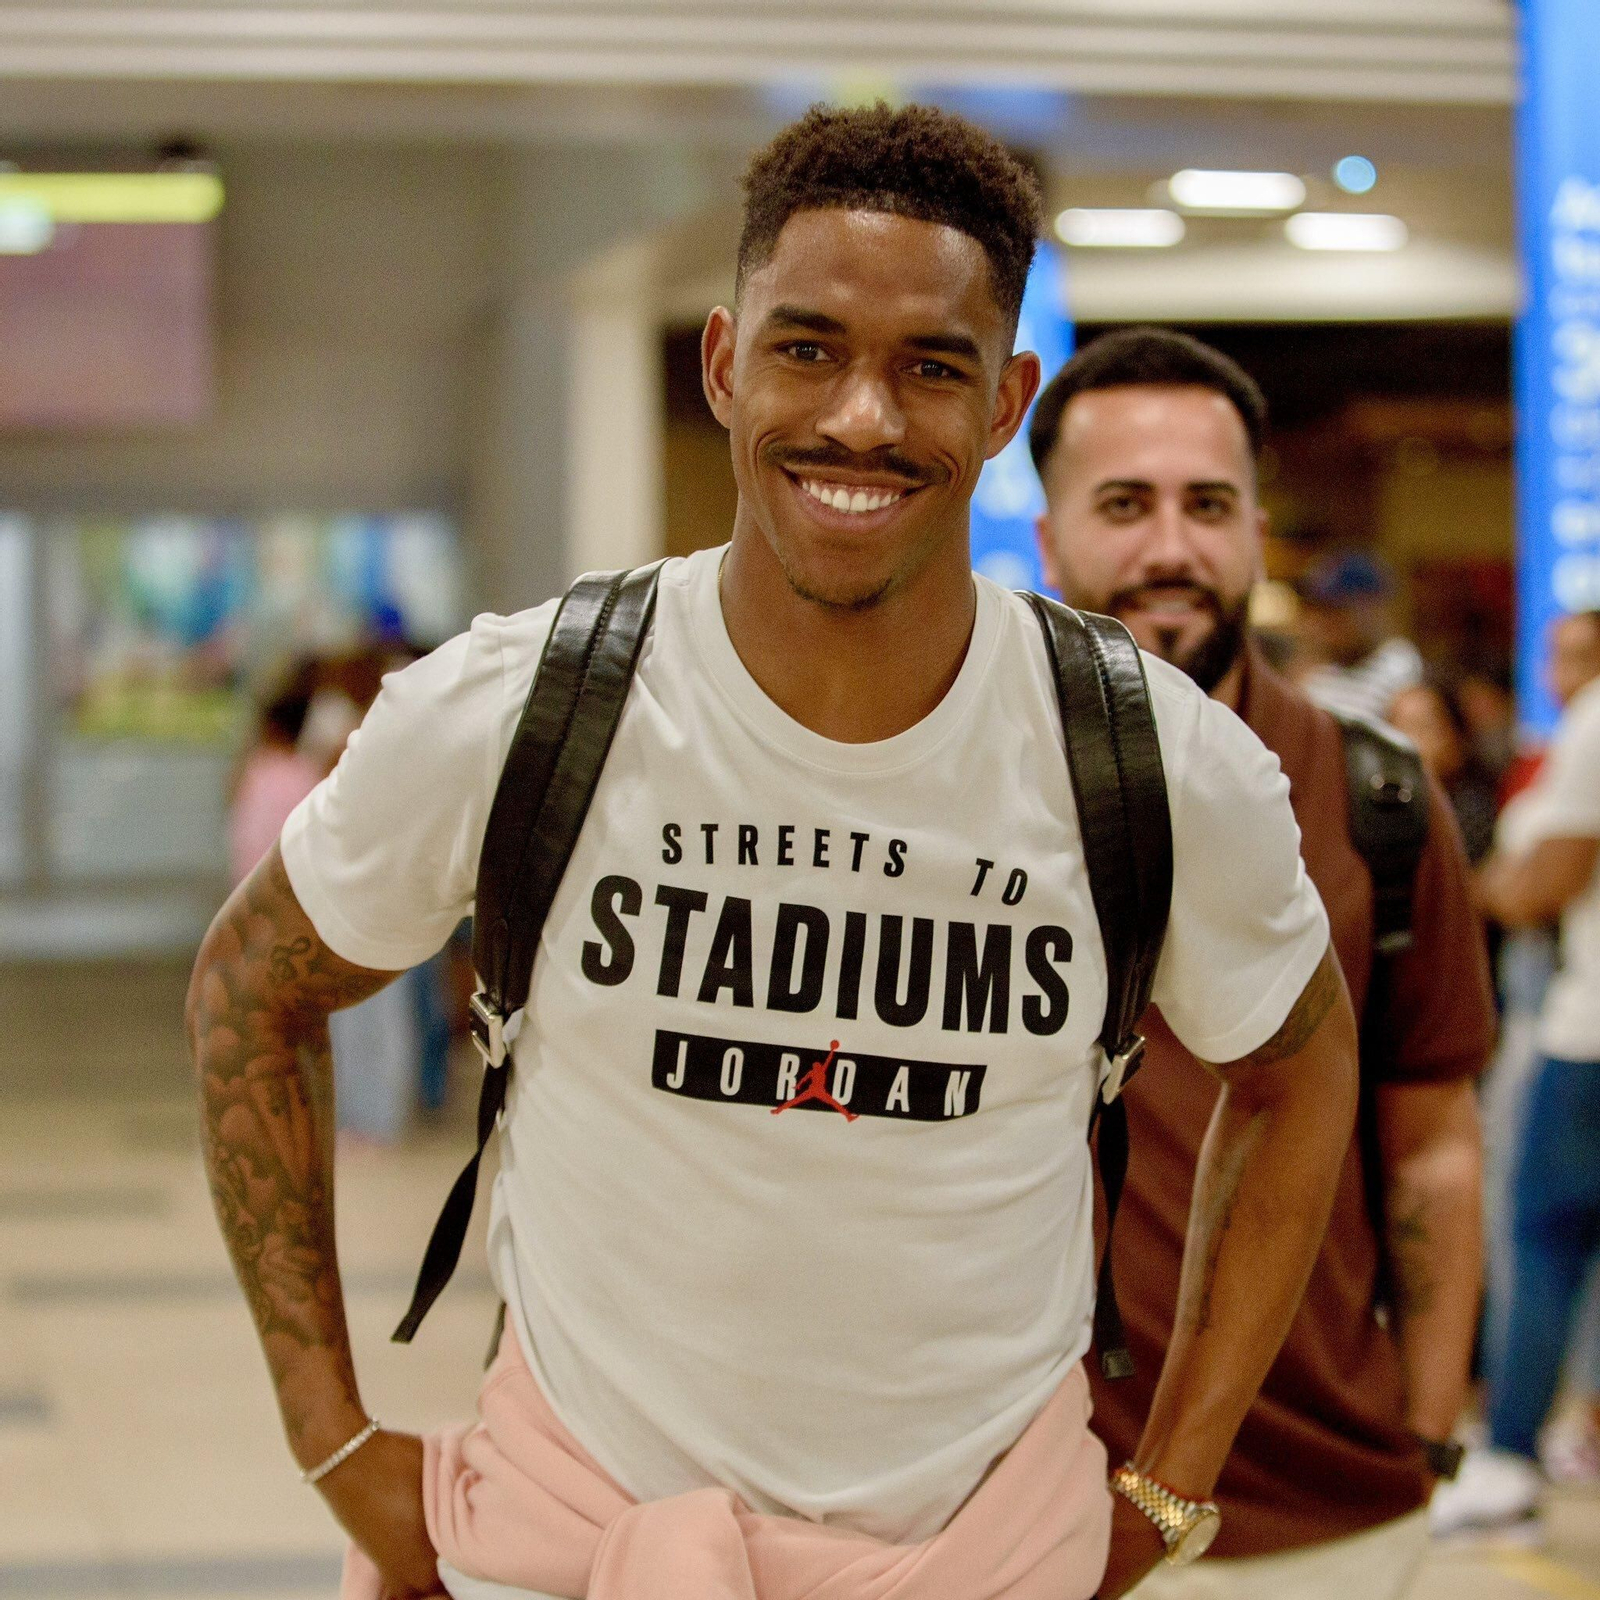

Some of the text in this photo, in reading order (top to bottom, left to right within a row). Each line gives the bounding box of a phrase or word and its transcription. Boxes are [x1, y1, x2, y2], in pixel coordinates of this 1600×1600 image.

[662, 823, 1028, 906] STREETS TO
[581, 875, 1074, 1036] STADIUMS
[666, 1040, 971, 1117] JORDAN
